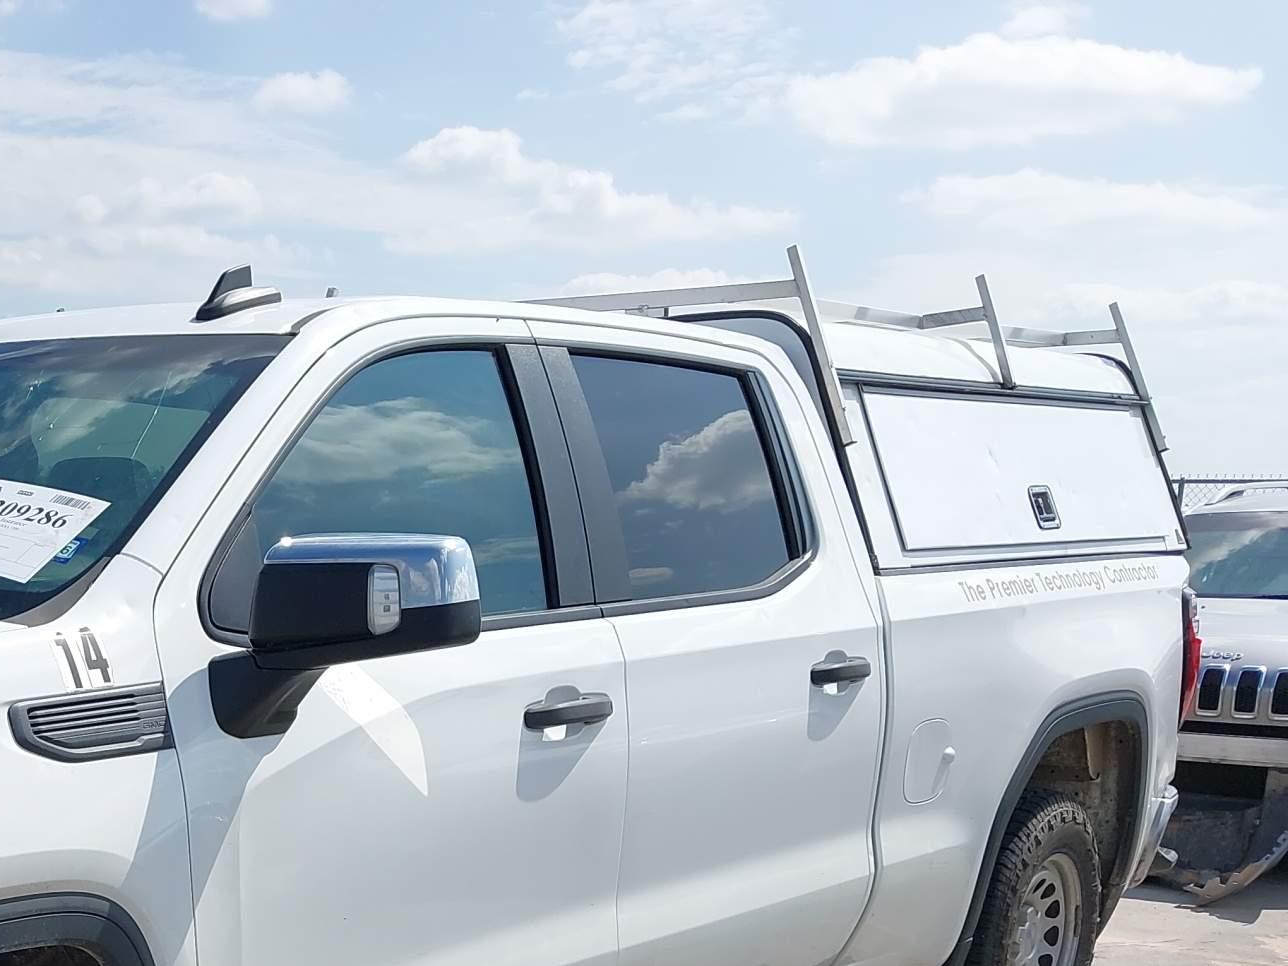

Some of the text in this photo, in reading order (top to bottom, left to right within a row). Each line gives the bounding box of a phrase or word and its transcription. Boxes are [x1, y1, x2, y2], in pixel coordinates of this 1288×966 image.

[958, 562, 1159, 602] The Premier Technology Contractor
[55, 626, 112, 689] 14
[1202, 649, 1244, 662] Jeep
